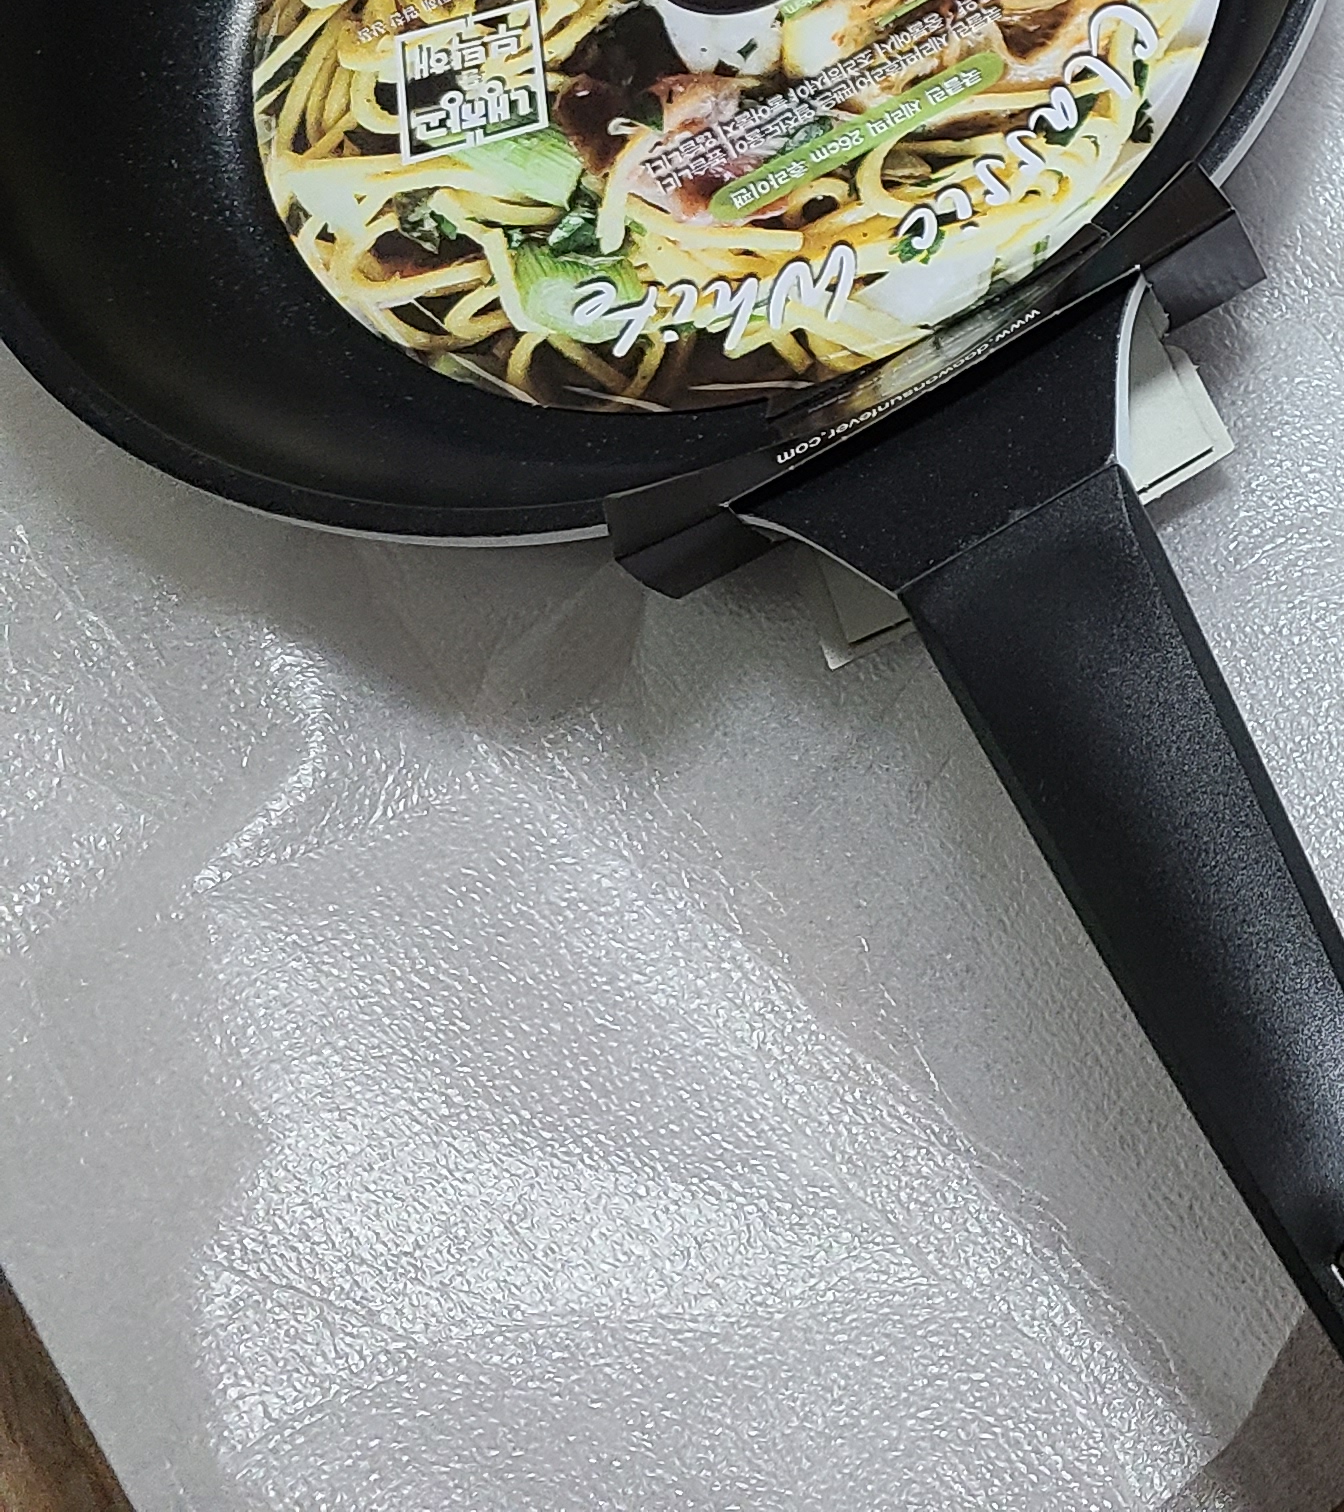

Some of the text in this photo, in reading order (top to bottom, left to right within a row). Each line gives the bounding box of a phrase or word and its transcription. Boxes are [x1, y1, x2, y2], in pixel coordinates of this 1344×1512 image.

[402, 17, 528, 81] 부탁해
[404, 71, 535, 143] 냉장고
[864, 94, 924, 138] 세라믹
[807, 125, 865, 167] 26cm
[574, 4, 1158, 356] Classic White
[727, 154, 809, 209] 후라이팬
